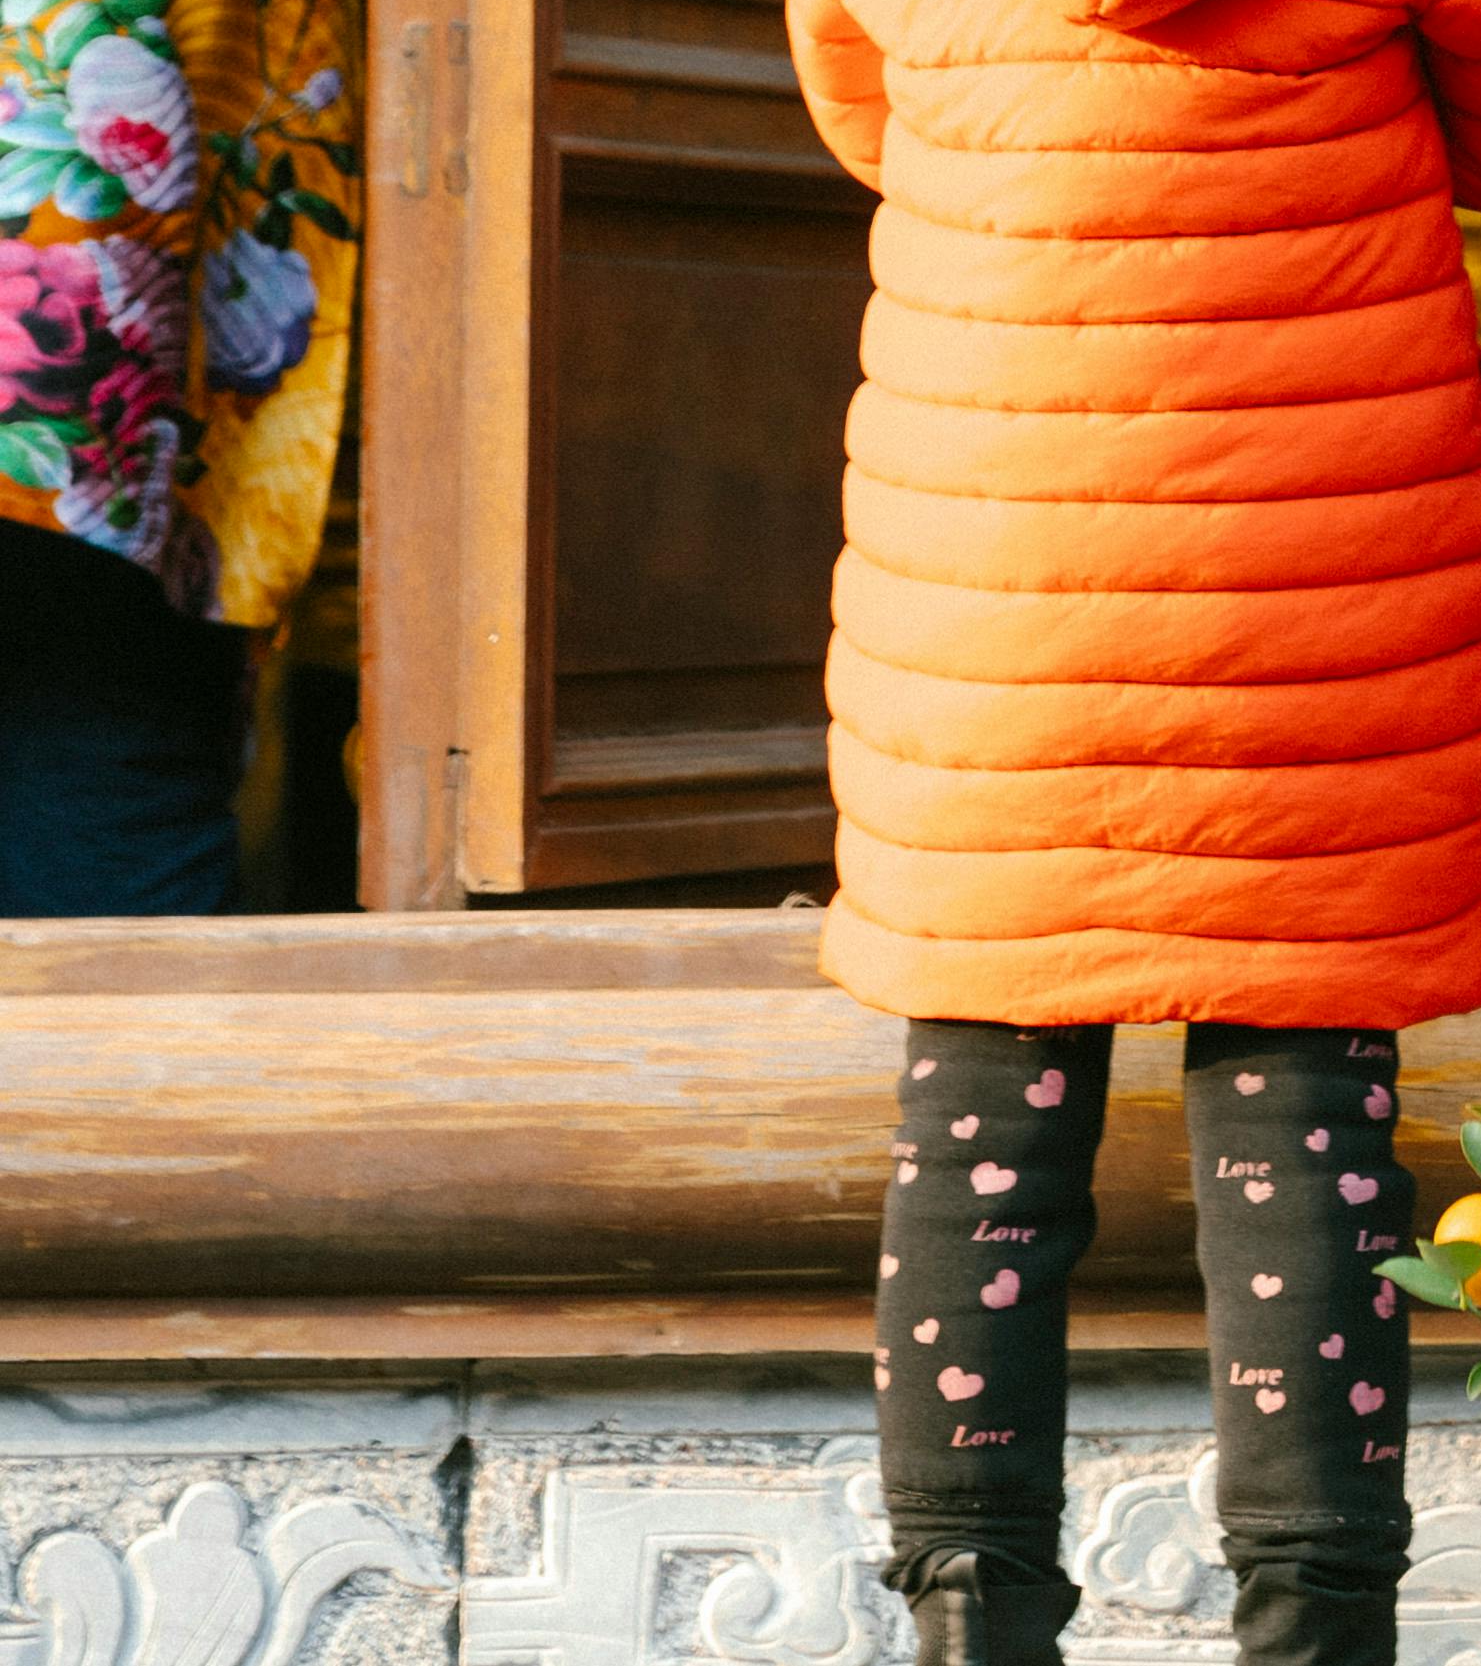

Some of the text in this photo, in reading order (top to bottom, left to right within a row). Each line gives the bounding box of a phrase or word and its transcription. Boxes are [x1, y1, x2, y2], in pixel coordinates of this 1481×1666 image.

[889, 1142, 919, 1160] ove
[1215, 1156, 1272, 1179] Love
[971, 1220, 1037, 1244] Love
[1356, 1230, 1398, 1251] Love
[1229, 1362, 1284, 1386] Love
[950, 1424, 1016, 1448] Love
